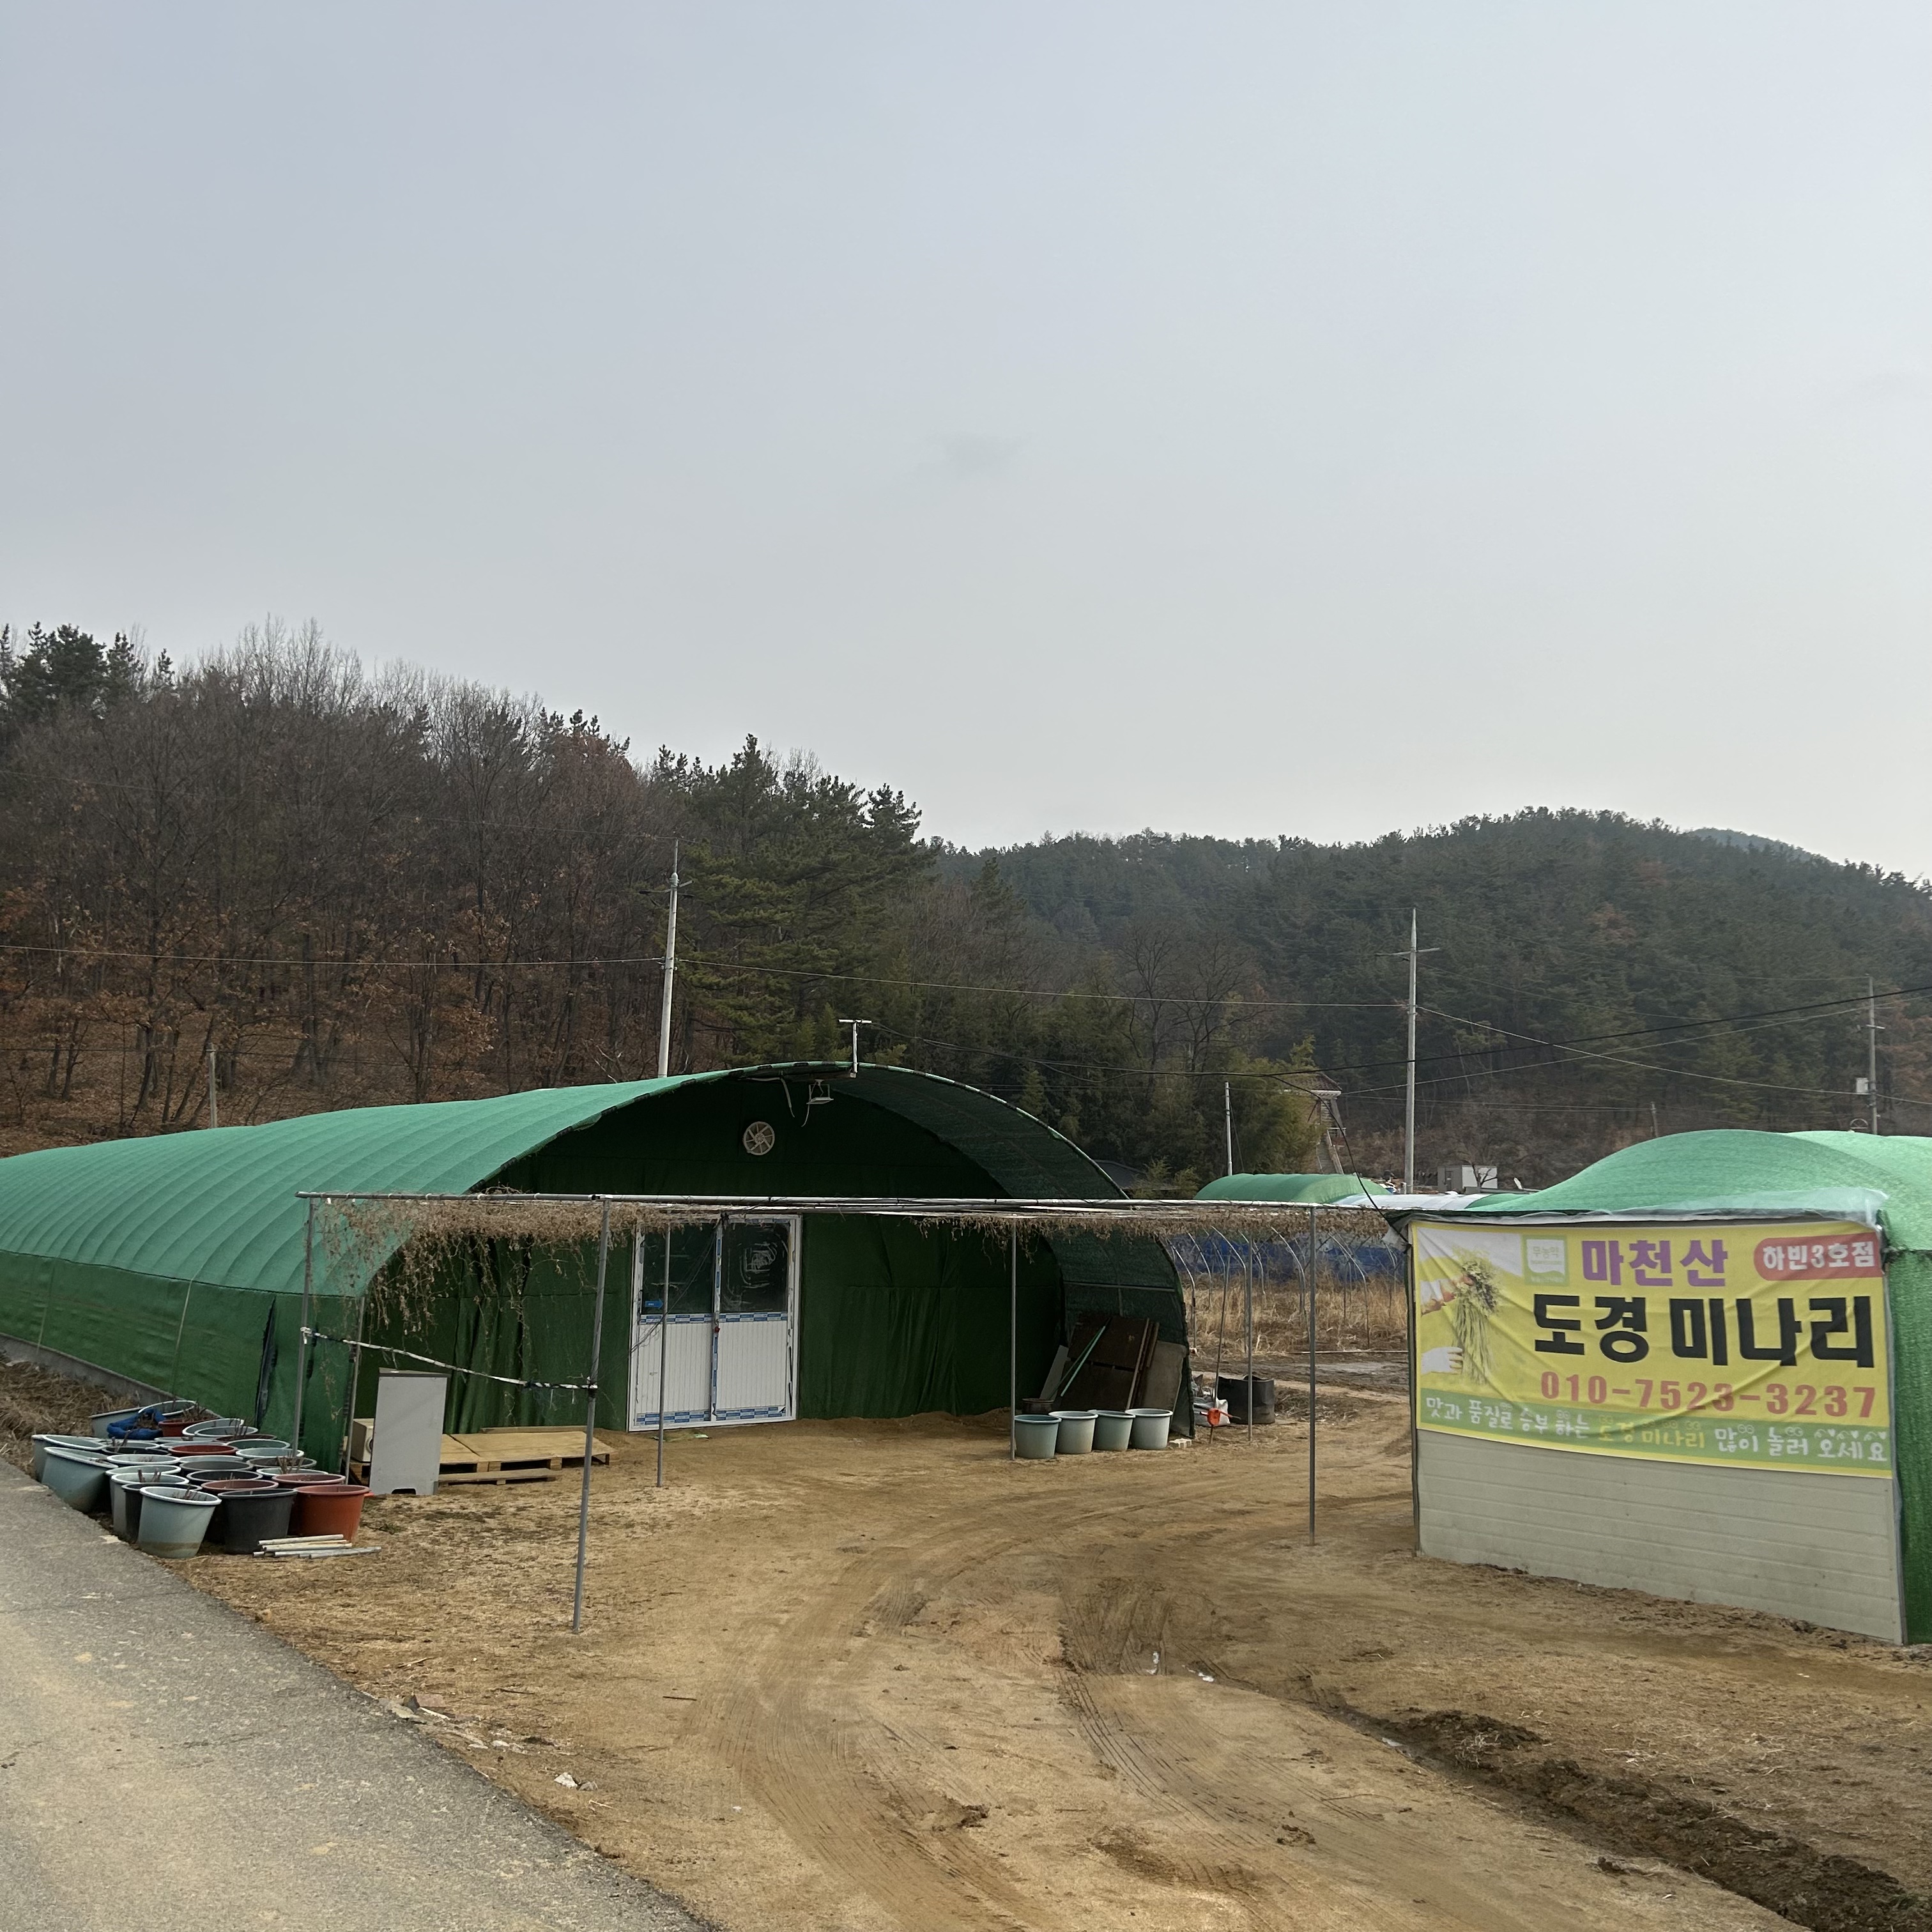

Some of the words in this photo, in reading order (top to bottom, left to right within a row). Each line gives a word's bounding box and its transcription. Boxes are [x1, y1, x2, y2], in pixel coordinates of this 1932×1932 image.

[1581, 1239, 1728, 1287] 마천산
[1762, 1241, 1876, 1271] 하빈3호점
[1534, 1293, 1650, 1363] 도경
[1669, 1296, 1875, 1368] 미나리
[1540, 1371, 1876, 1418] 010-7523-3237
[1425, 1397, 1463, 1420] 맛과
[1468, 1399, 1514, 1430] 품질로
[1519, 1407, 1549, 1434] 승부
[1554, 1413, 1590, 1439] 하는
[1641, 1428, 1705, 1449] 미나리
[1714, 1426, 1759, 1453] 많이
[1767, 1426, 1809, 1457] 놀러
[1817, 1439, 1888, 1462] 오세요
